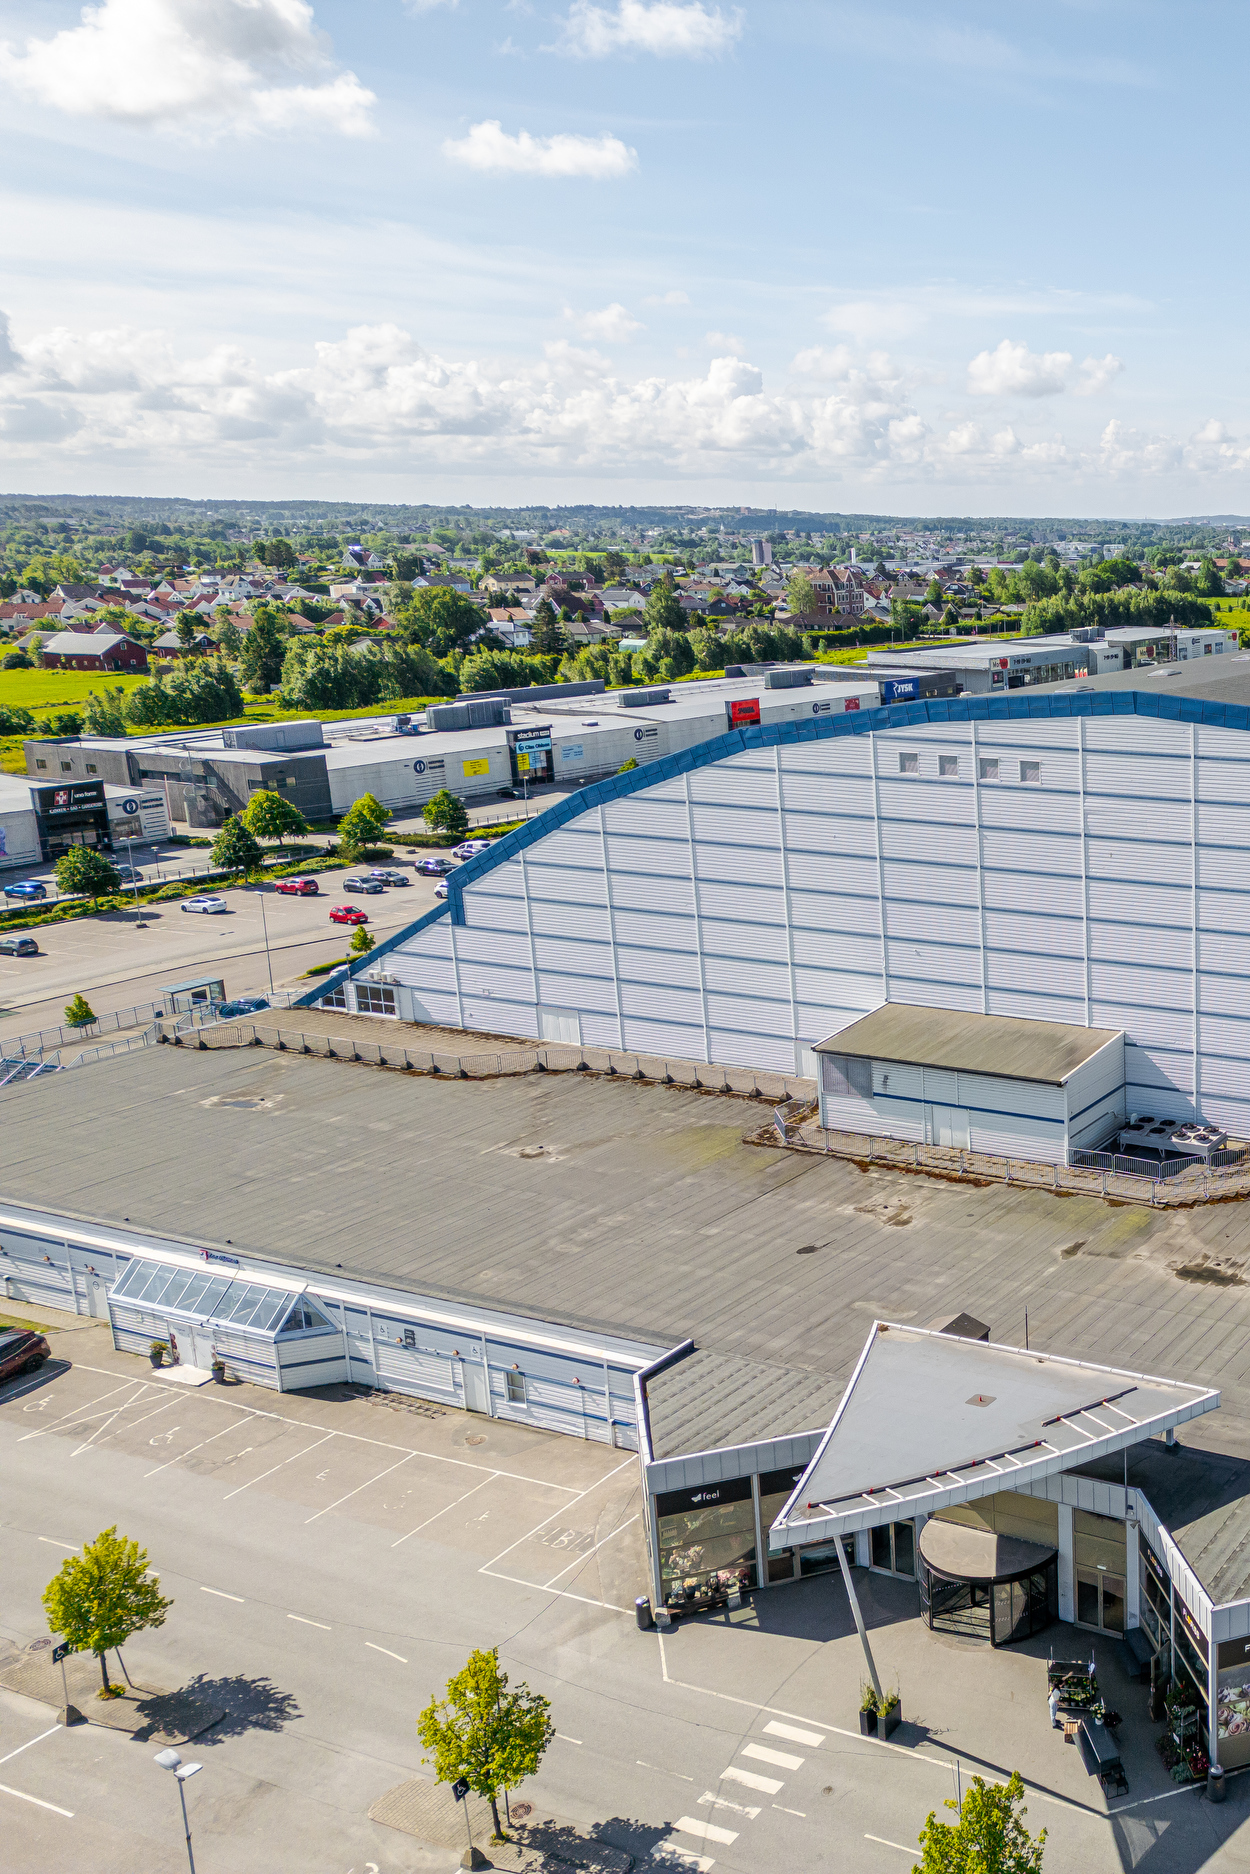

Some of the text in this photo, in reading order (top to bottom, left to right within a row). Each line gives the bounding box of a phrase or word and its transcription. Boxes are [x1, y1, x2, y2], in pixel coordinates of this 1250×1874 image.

[897, 683, 913, 692] JYSK
[517, 731, 539, 739] stadium
[703, 1489, 719, 1500] feel
